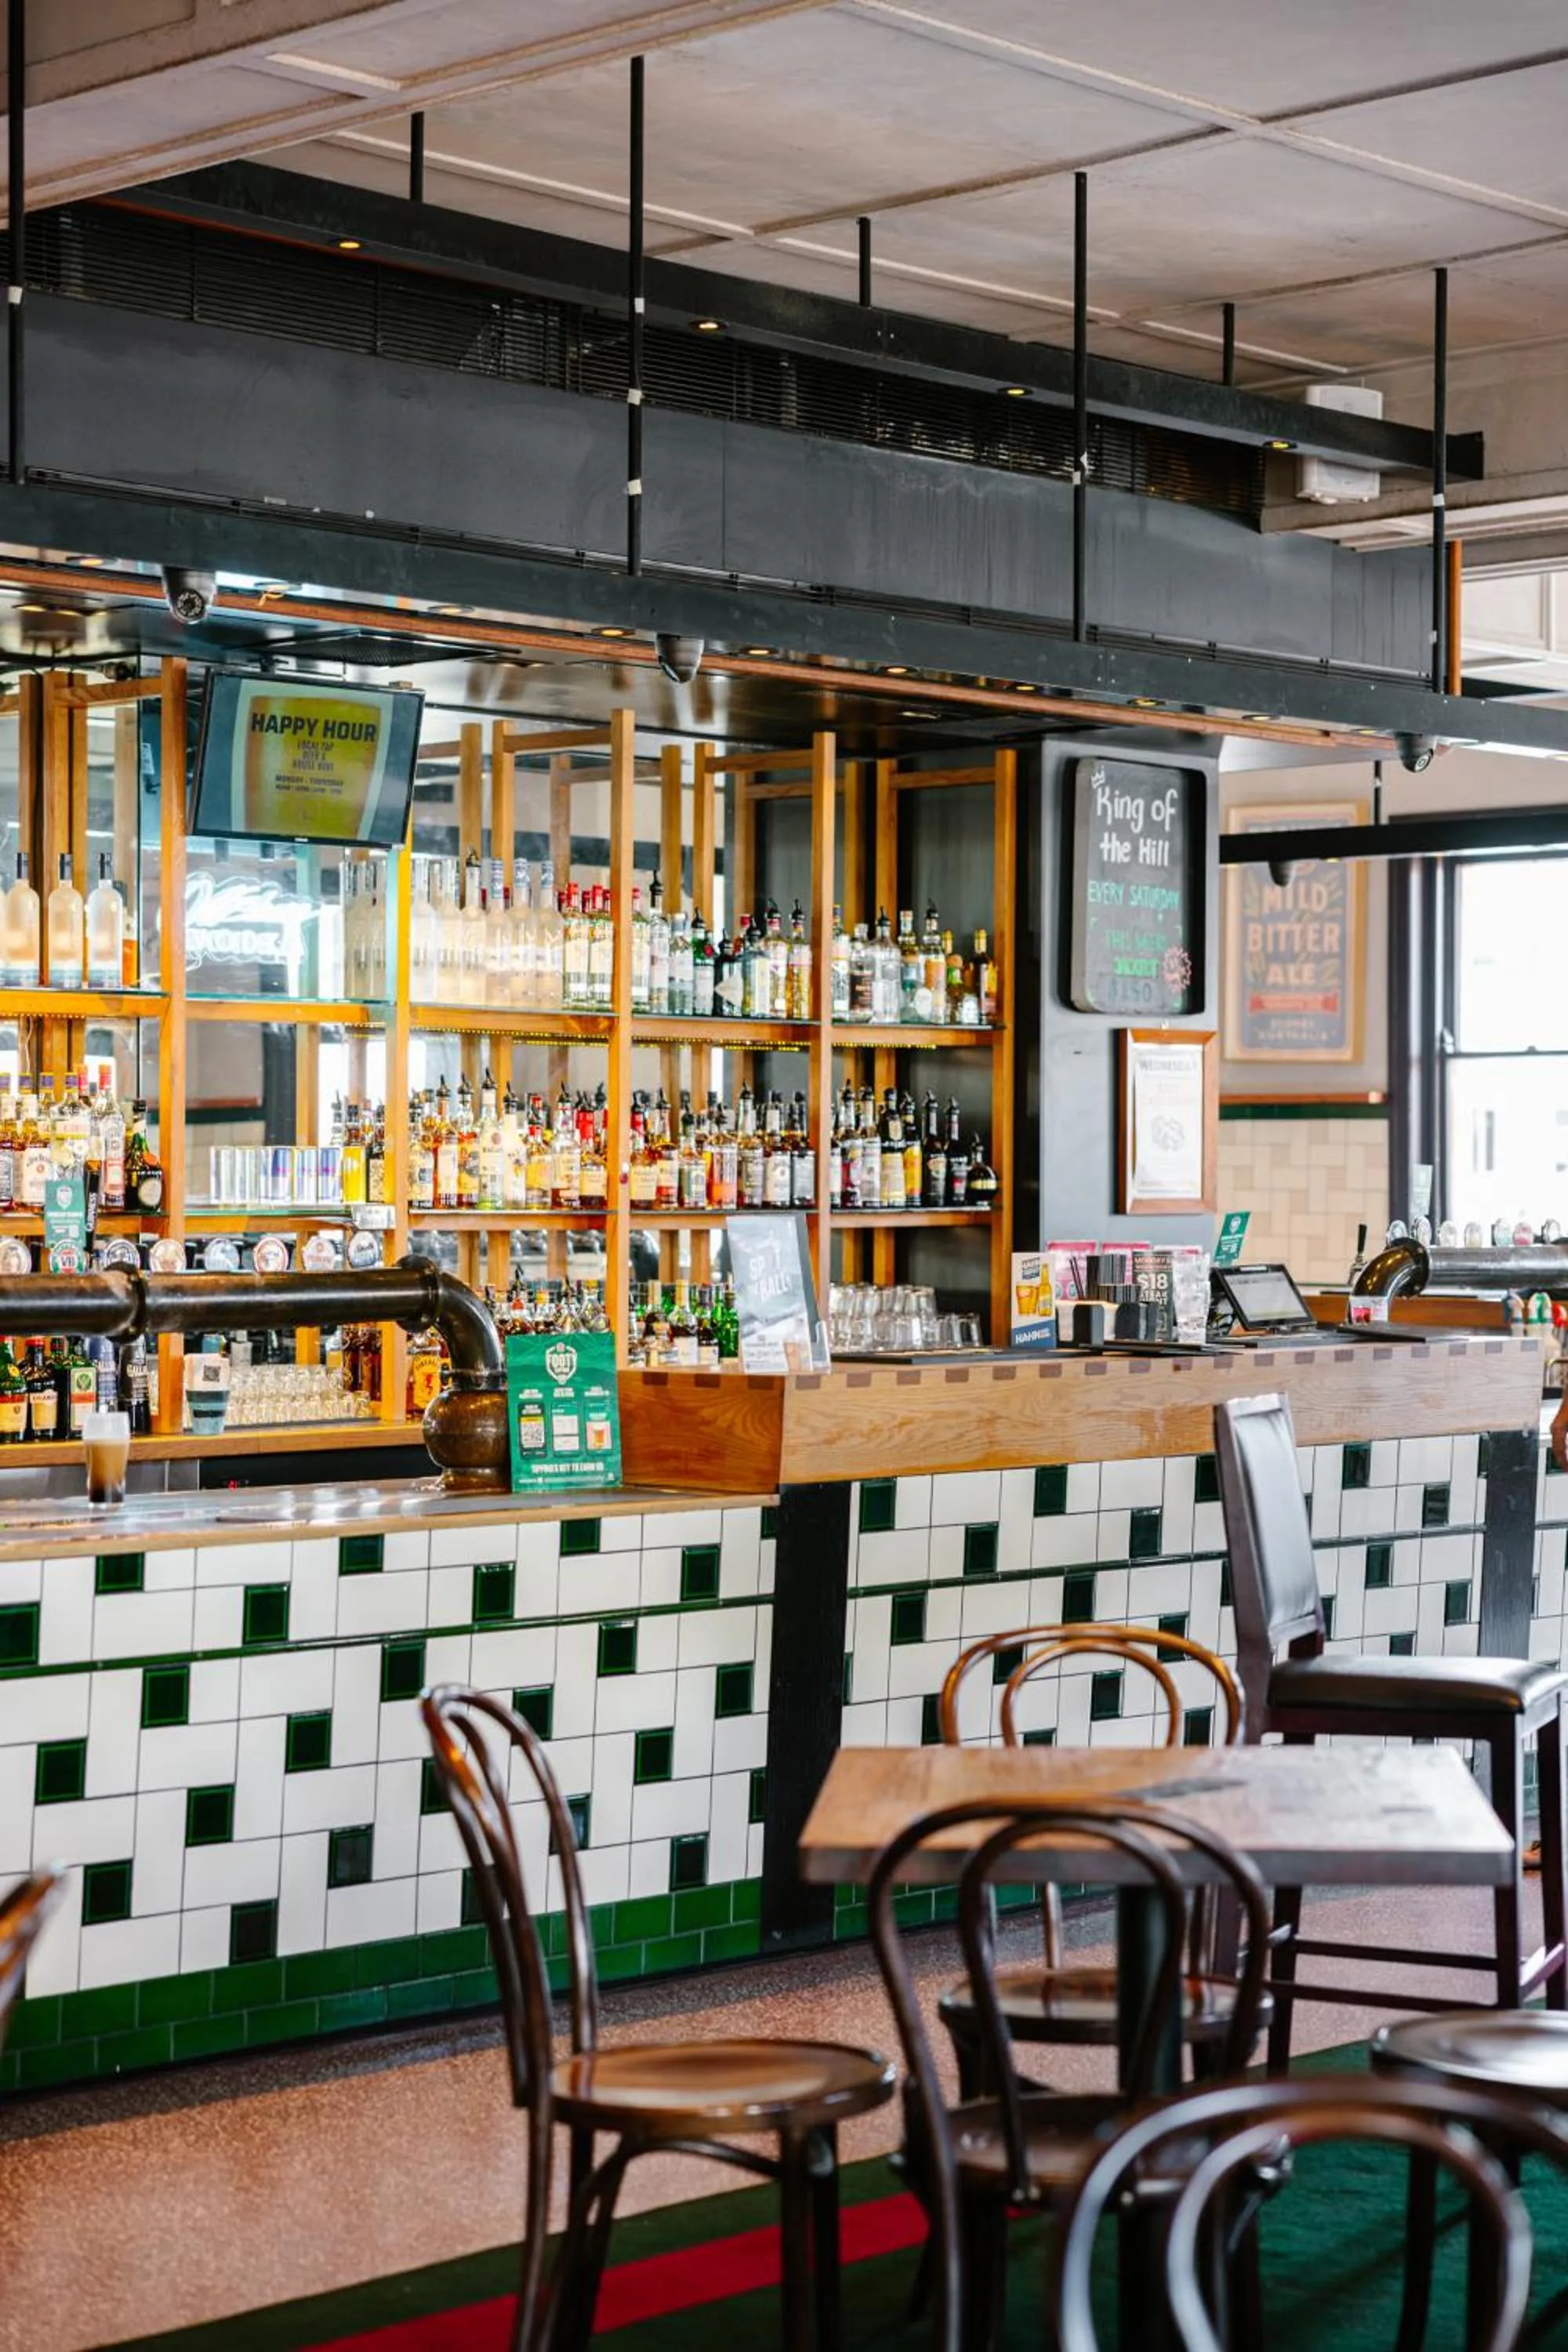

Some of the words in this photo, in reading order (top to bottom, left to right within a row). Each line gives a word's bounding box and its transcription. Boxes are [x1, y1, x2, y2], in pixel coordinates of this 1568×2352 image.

[251, 713, 318, 737] HAPPY
[322, 720, 377, 742] HOUR
[1096, 786, 1144, 833] King
[1151, 789, 1178, 832] of
[1099, 832, 1131, 863] the
[1139, 838, 1169, 866] Hill
[1087, 880, 1124, 906] EVERY
[1129, 884, 1179, 911] SATURDAY
[1247, 921, 1340, 953] BITTER
[1266, 963, 1317, 985] ALE
[1137, 1272, 1168, 1290] $18
